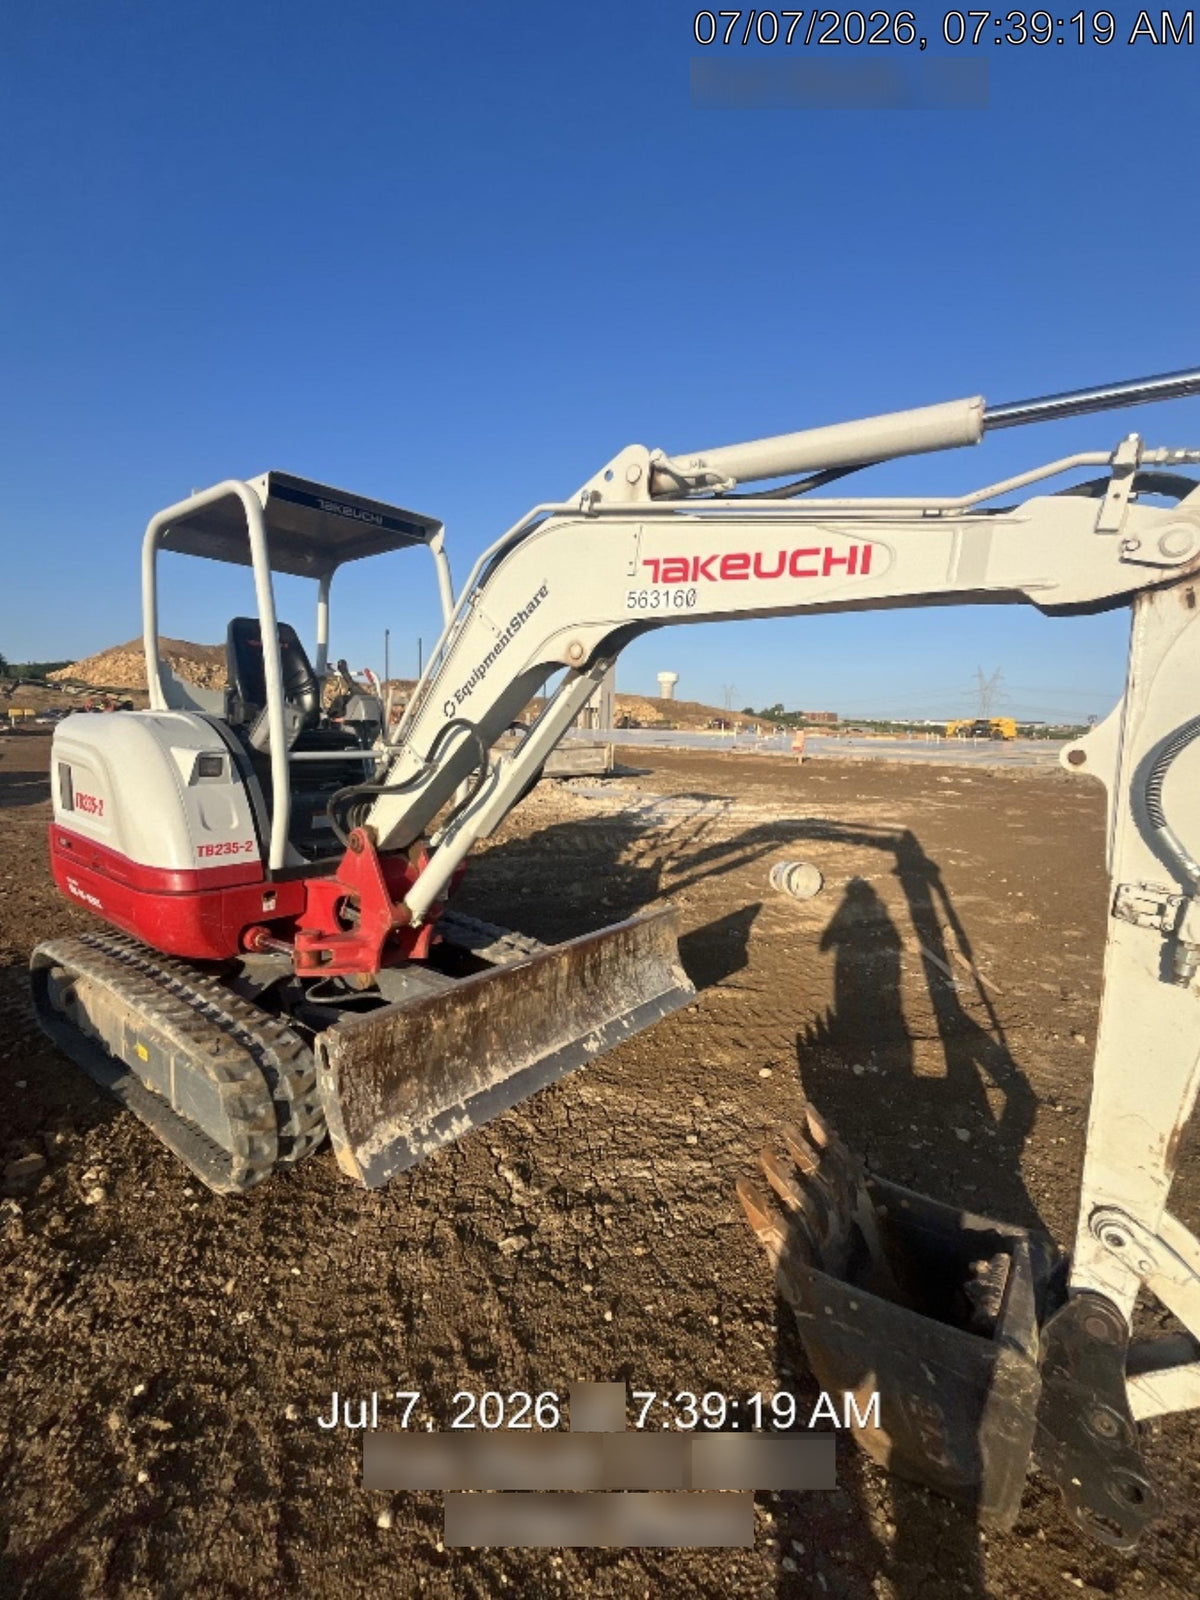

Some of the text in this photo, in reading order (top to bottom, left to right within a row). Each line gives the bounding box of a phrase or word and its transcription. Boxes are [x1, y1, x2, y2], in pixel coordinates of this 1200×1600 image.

[626, 588, 697, 609] 563160
[454, 584, 549, 704] EquipmentShare
[196, 840, 254, 858] TB235-2
